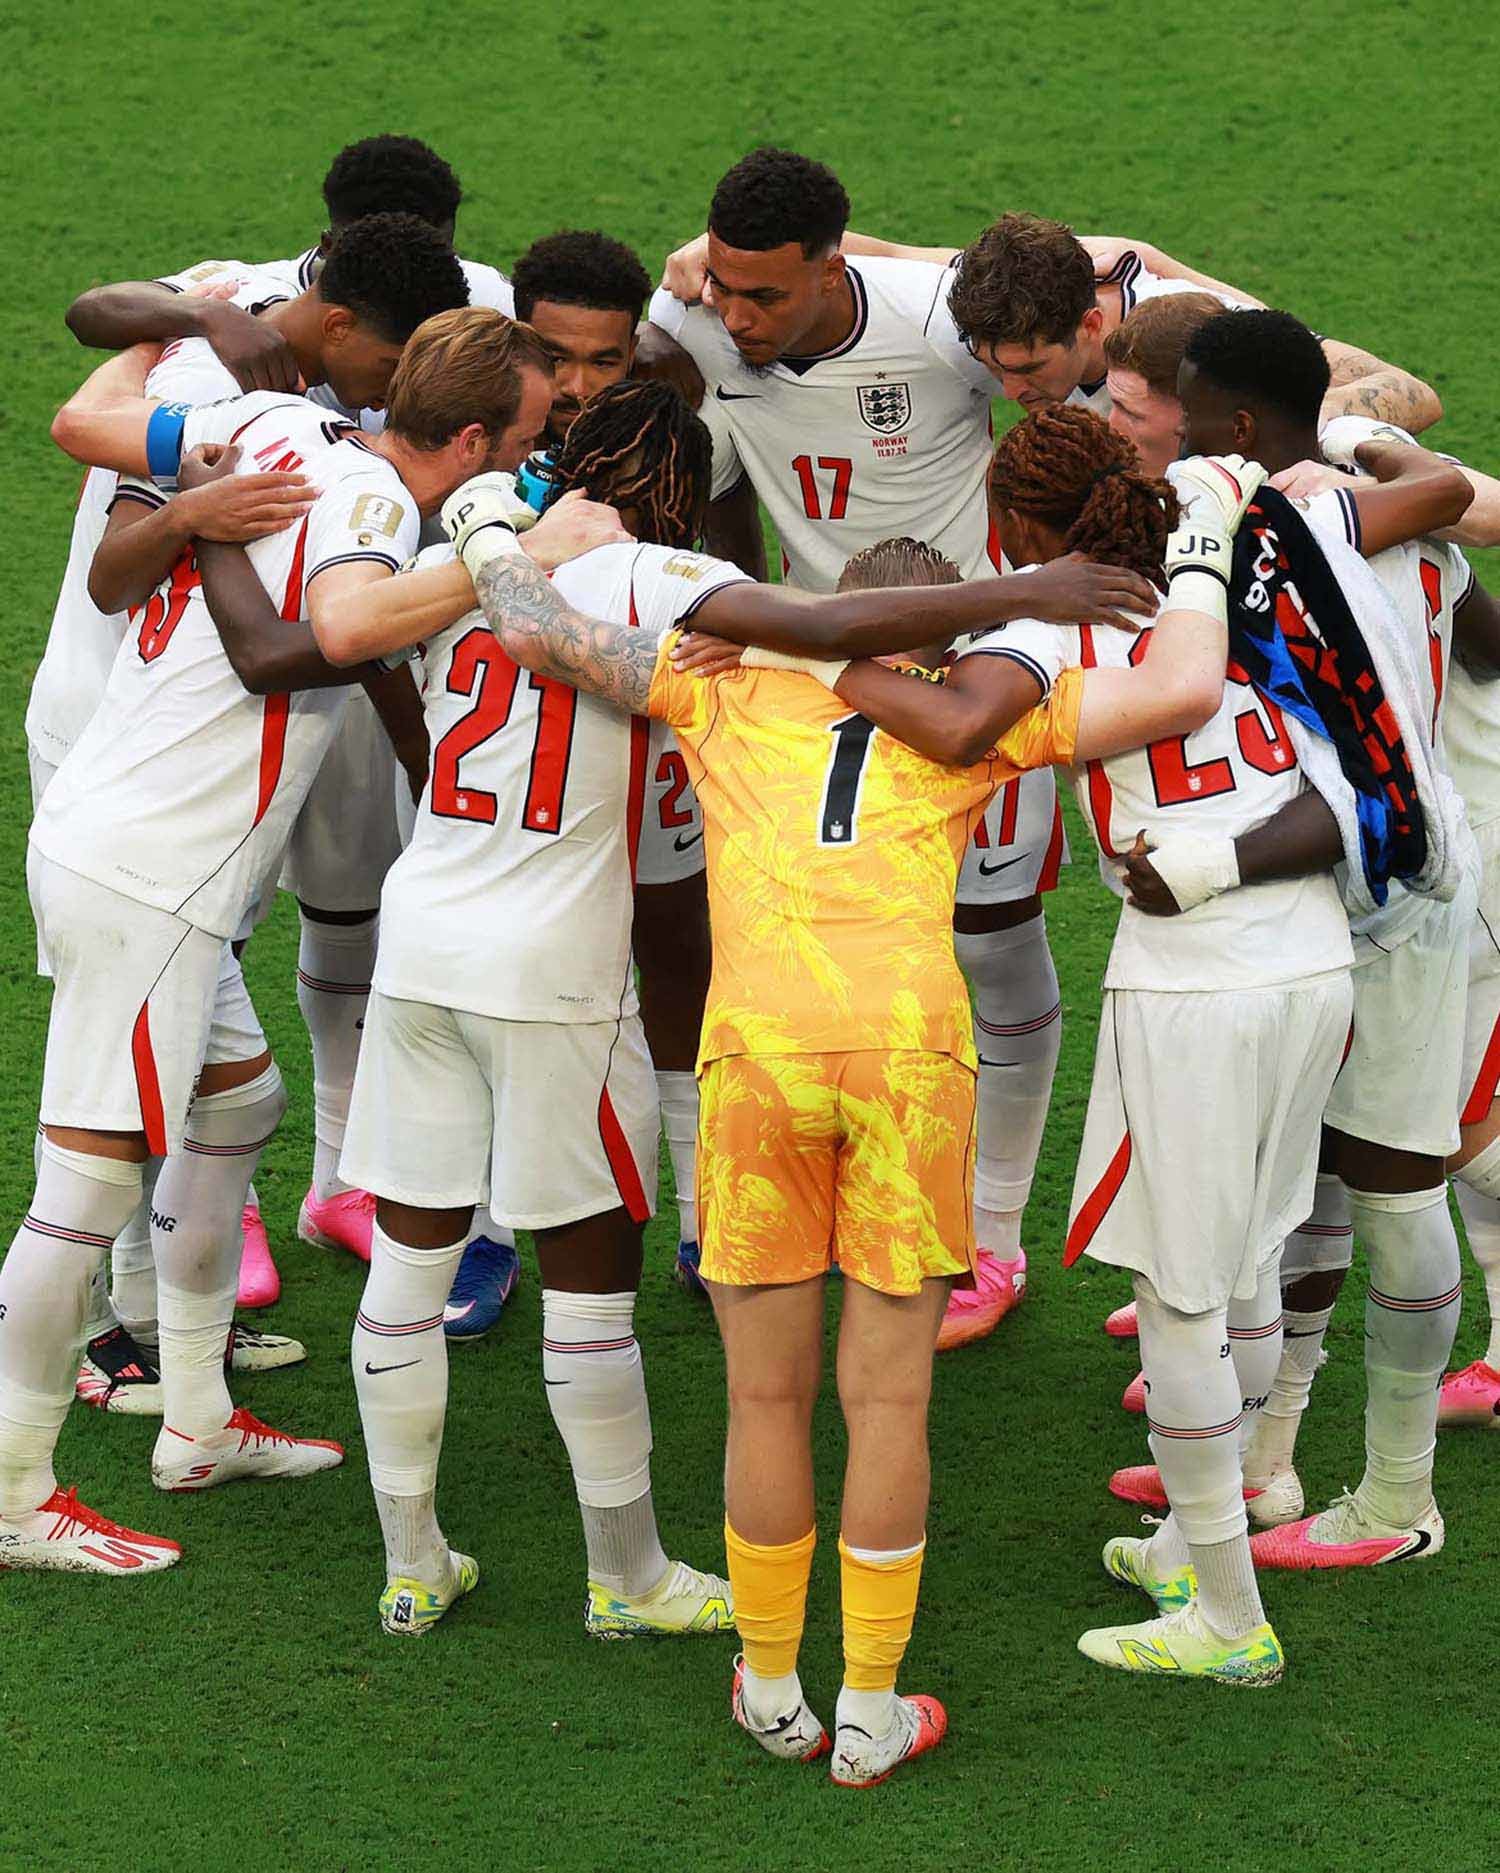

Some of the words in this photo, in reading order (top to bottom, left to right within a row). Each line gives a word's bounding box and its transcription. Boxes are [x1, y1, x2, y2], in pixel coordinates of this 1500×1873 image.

[872, 436, 908, 448] NORWAY
[792, 455, 852, 519] 17
[449, 501, 475, 542] JP
[1178, 535, 1221, 555] JP
[431, 627, 578, 834] 21
[822, 712, 877, 845] 1
